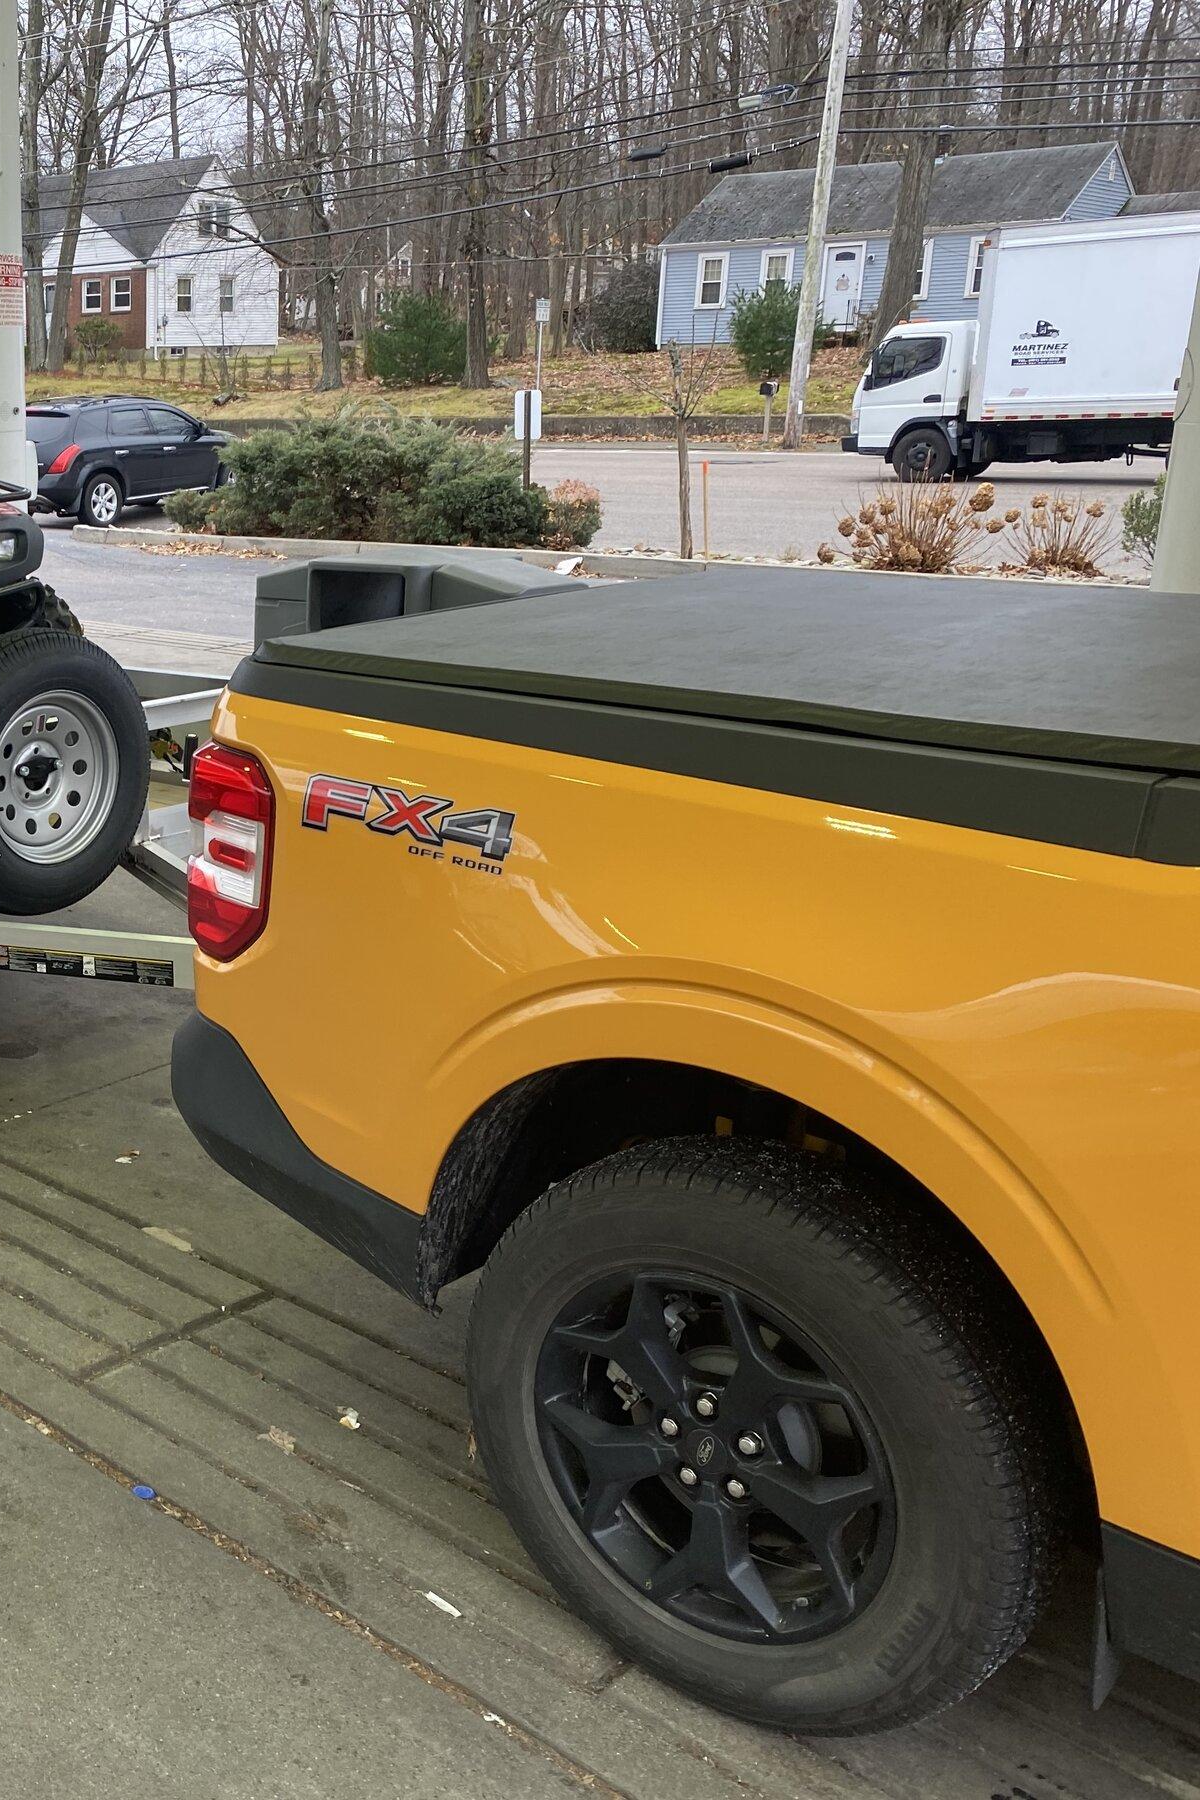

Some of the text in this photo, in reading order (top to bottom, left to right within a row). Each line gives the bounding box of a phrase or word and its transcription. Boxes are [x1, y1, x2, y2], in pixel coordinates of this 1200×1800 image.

[1012, 343, 1068, 351] MARTINEZ
[301, 773, 516, 862] FX4
[408, 845, 503, 876] OFF ROAD
